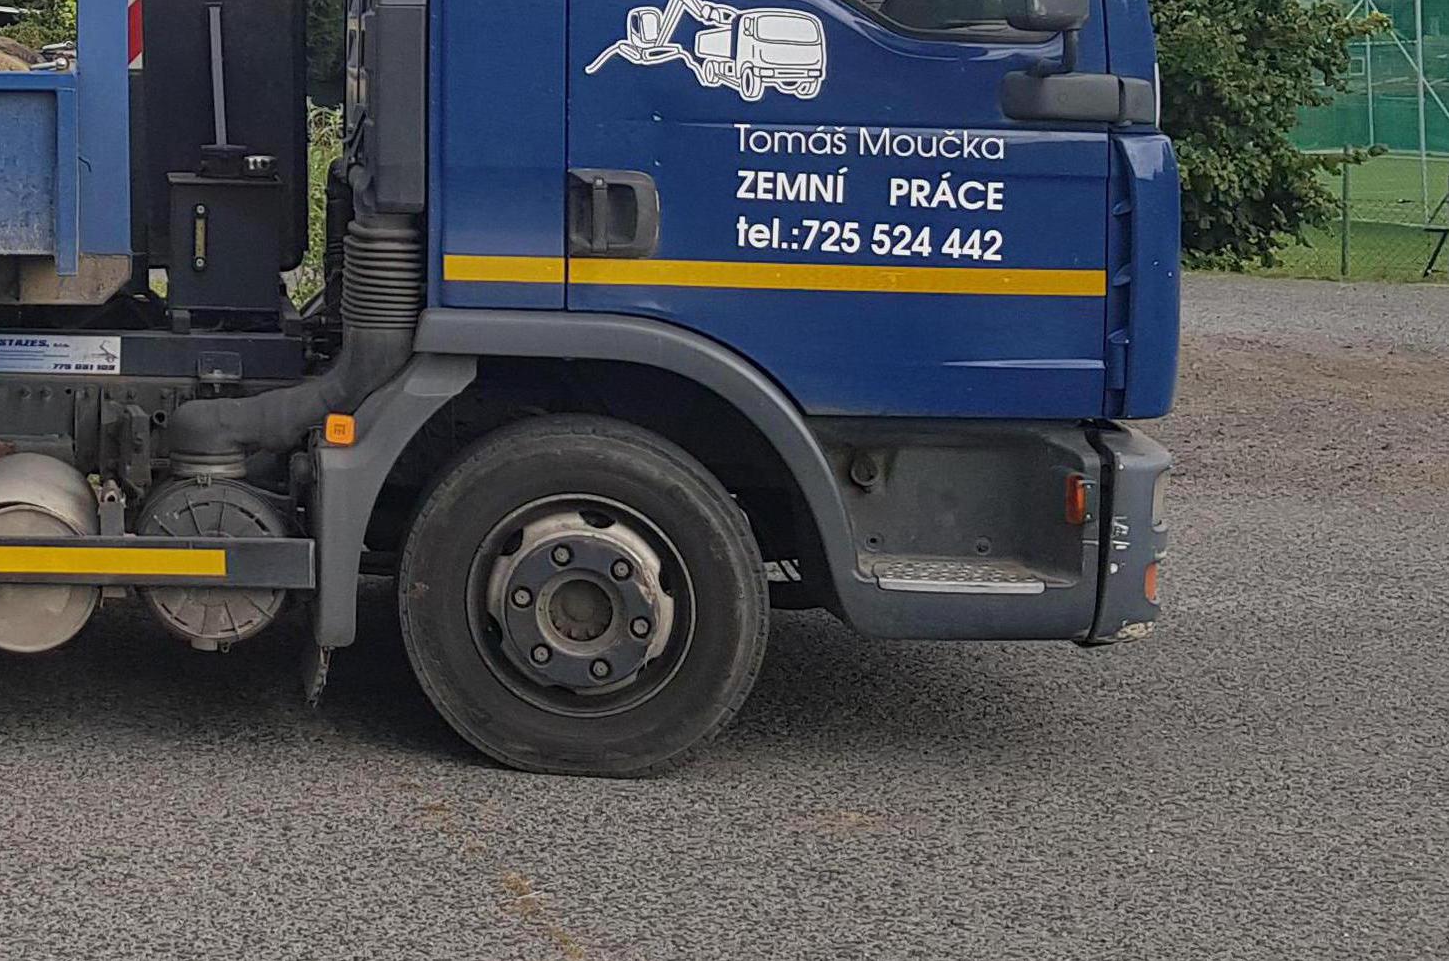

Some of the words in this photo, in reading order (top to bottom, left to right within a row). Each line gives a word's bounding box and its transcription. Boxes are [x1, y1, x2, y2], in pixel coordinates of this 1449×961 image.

[734, 123, 846, 155] Tomáš
[859, 127, 1004, 160] Moučka
[736, 166, 848, 204] ZEMNÍ
[889, 171, 1004, 211] PRÁCE
[870, 223, 932, 257] 524
[941, 227, 1002, 261] 442
